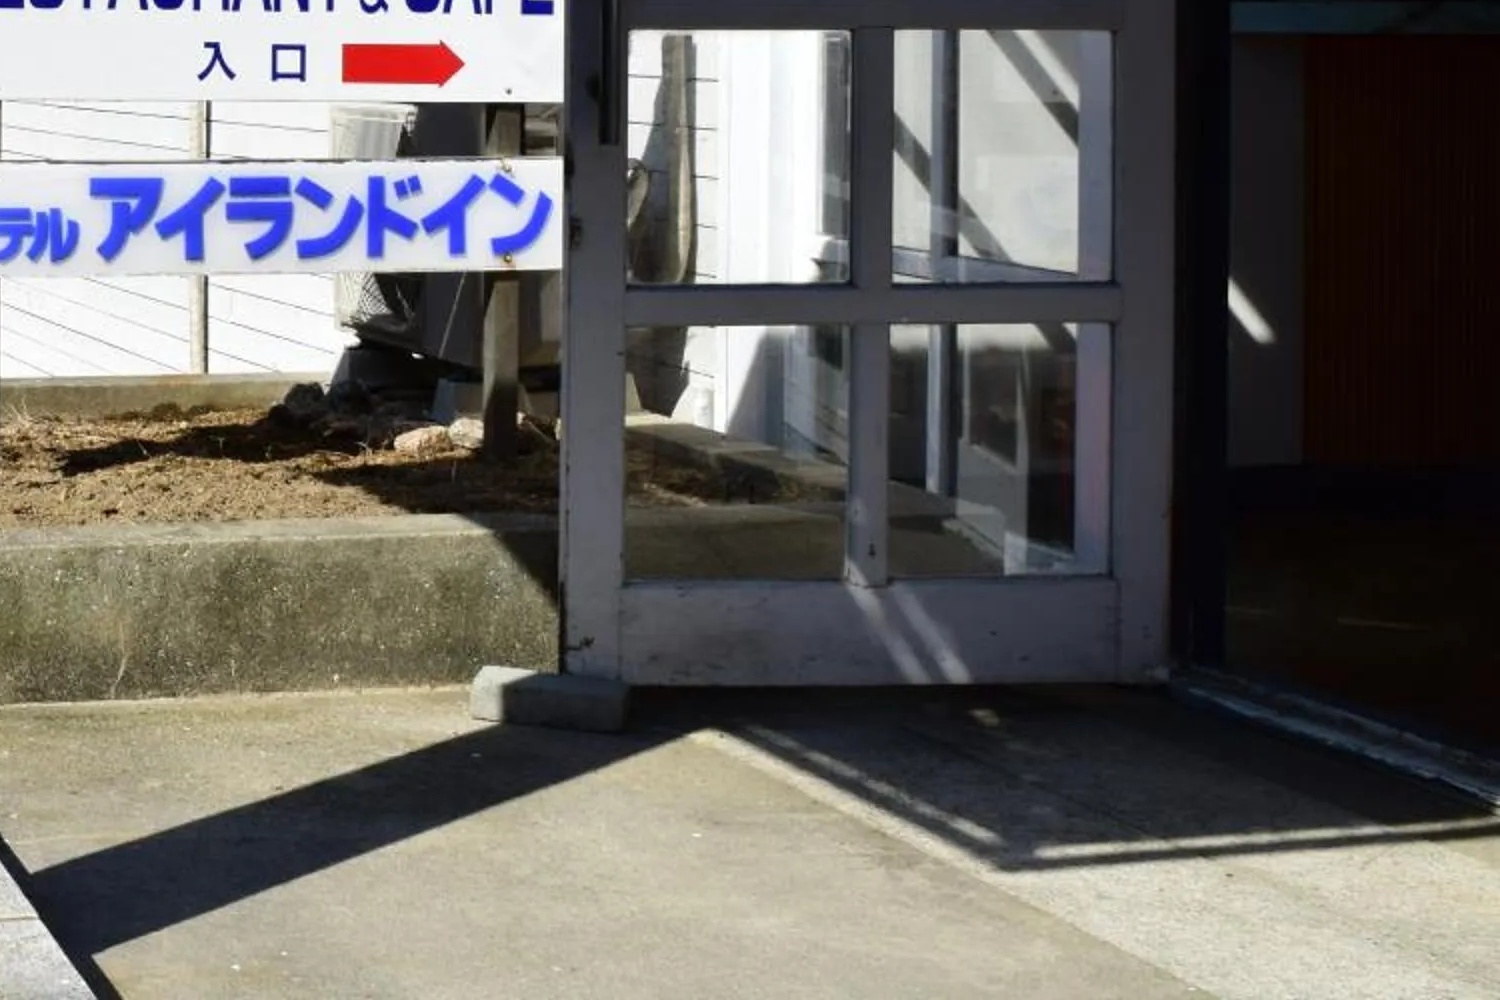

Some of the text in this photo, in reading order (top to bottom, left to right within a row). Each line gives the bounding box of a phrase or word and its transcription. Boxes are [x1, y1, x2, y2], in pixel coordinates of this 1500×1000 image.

[89, 173, 554, 263] アイランドイン
